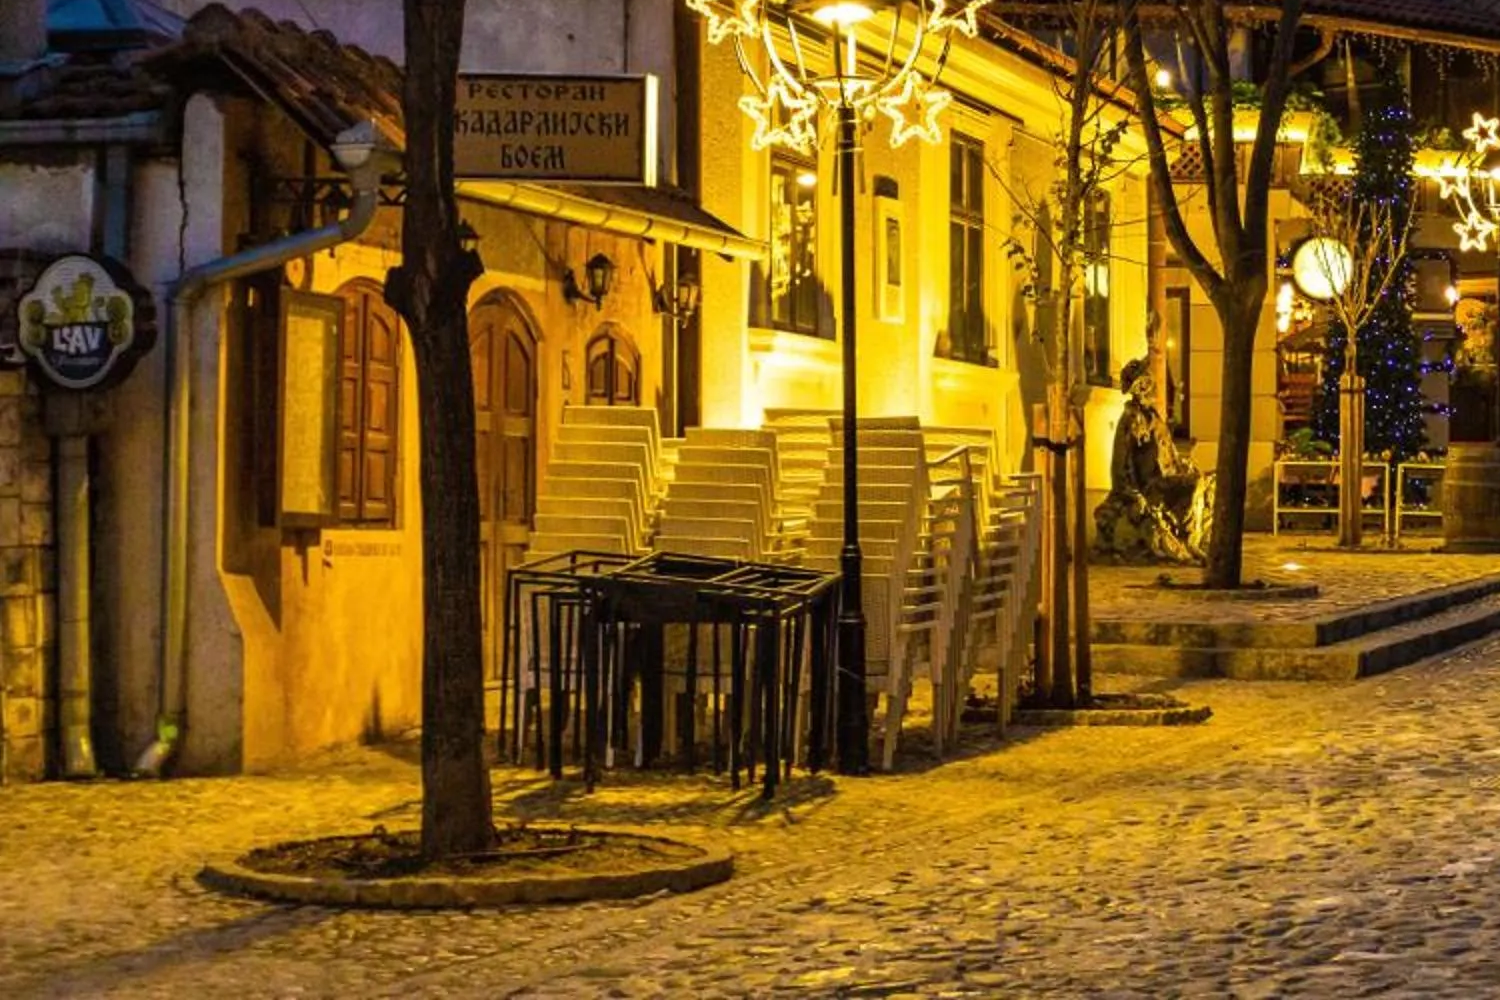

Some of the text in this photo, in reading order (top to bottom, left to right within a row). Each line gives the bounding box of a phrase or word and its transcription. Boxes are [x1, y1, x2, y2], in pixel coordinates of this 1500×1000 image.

[467, 83, 606, 102] РЕСТОРАН
[454, 109, 630, 137] КАДАРЛИЈСКИ
[500, 144, 565, 169] БОЕМ
